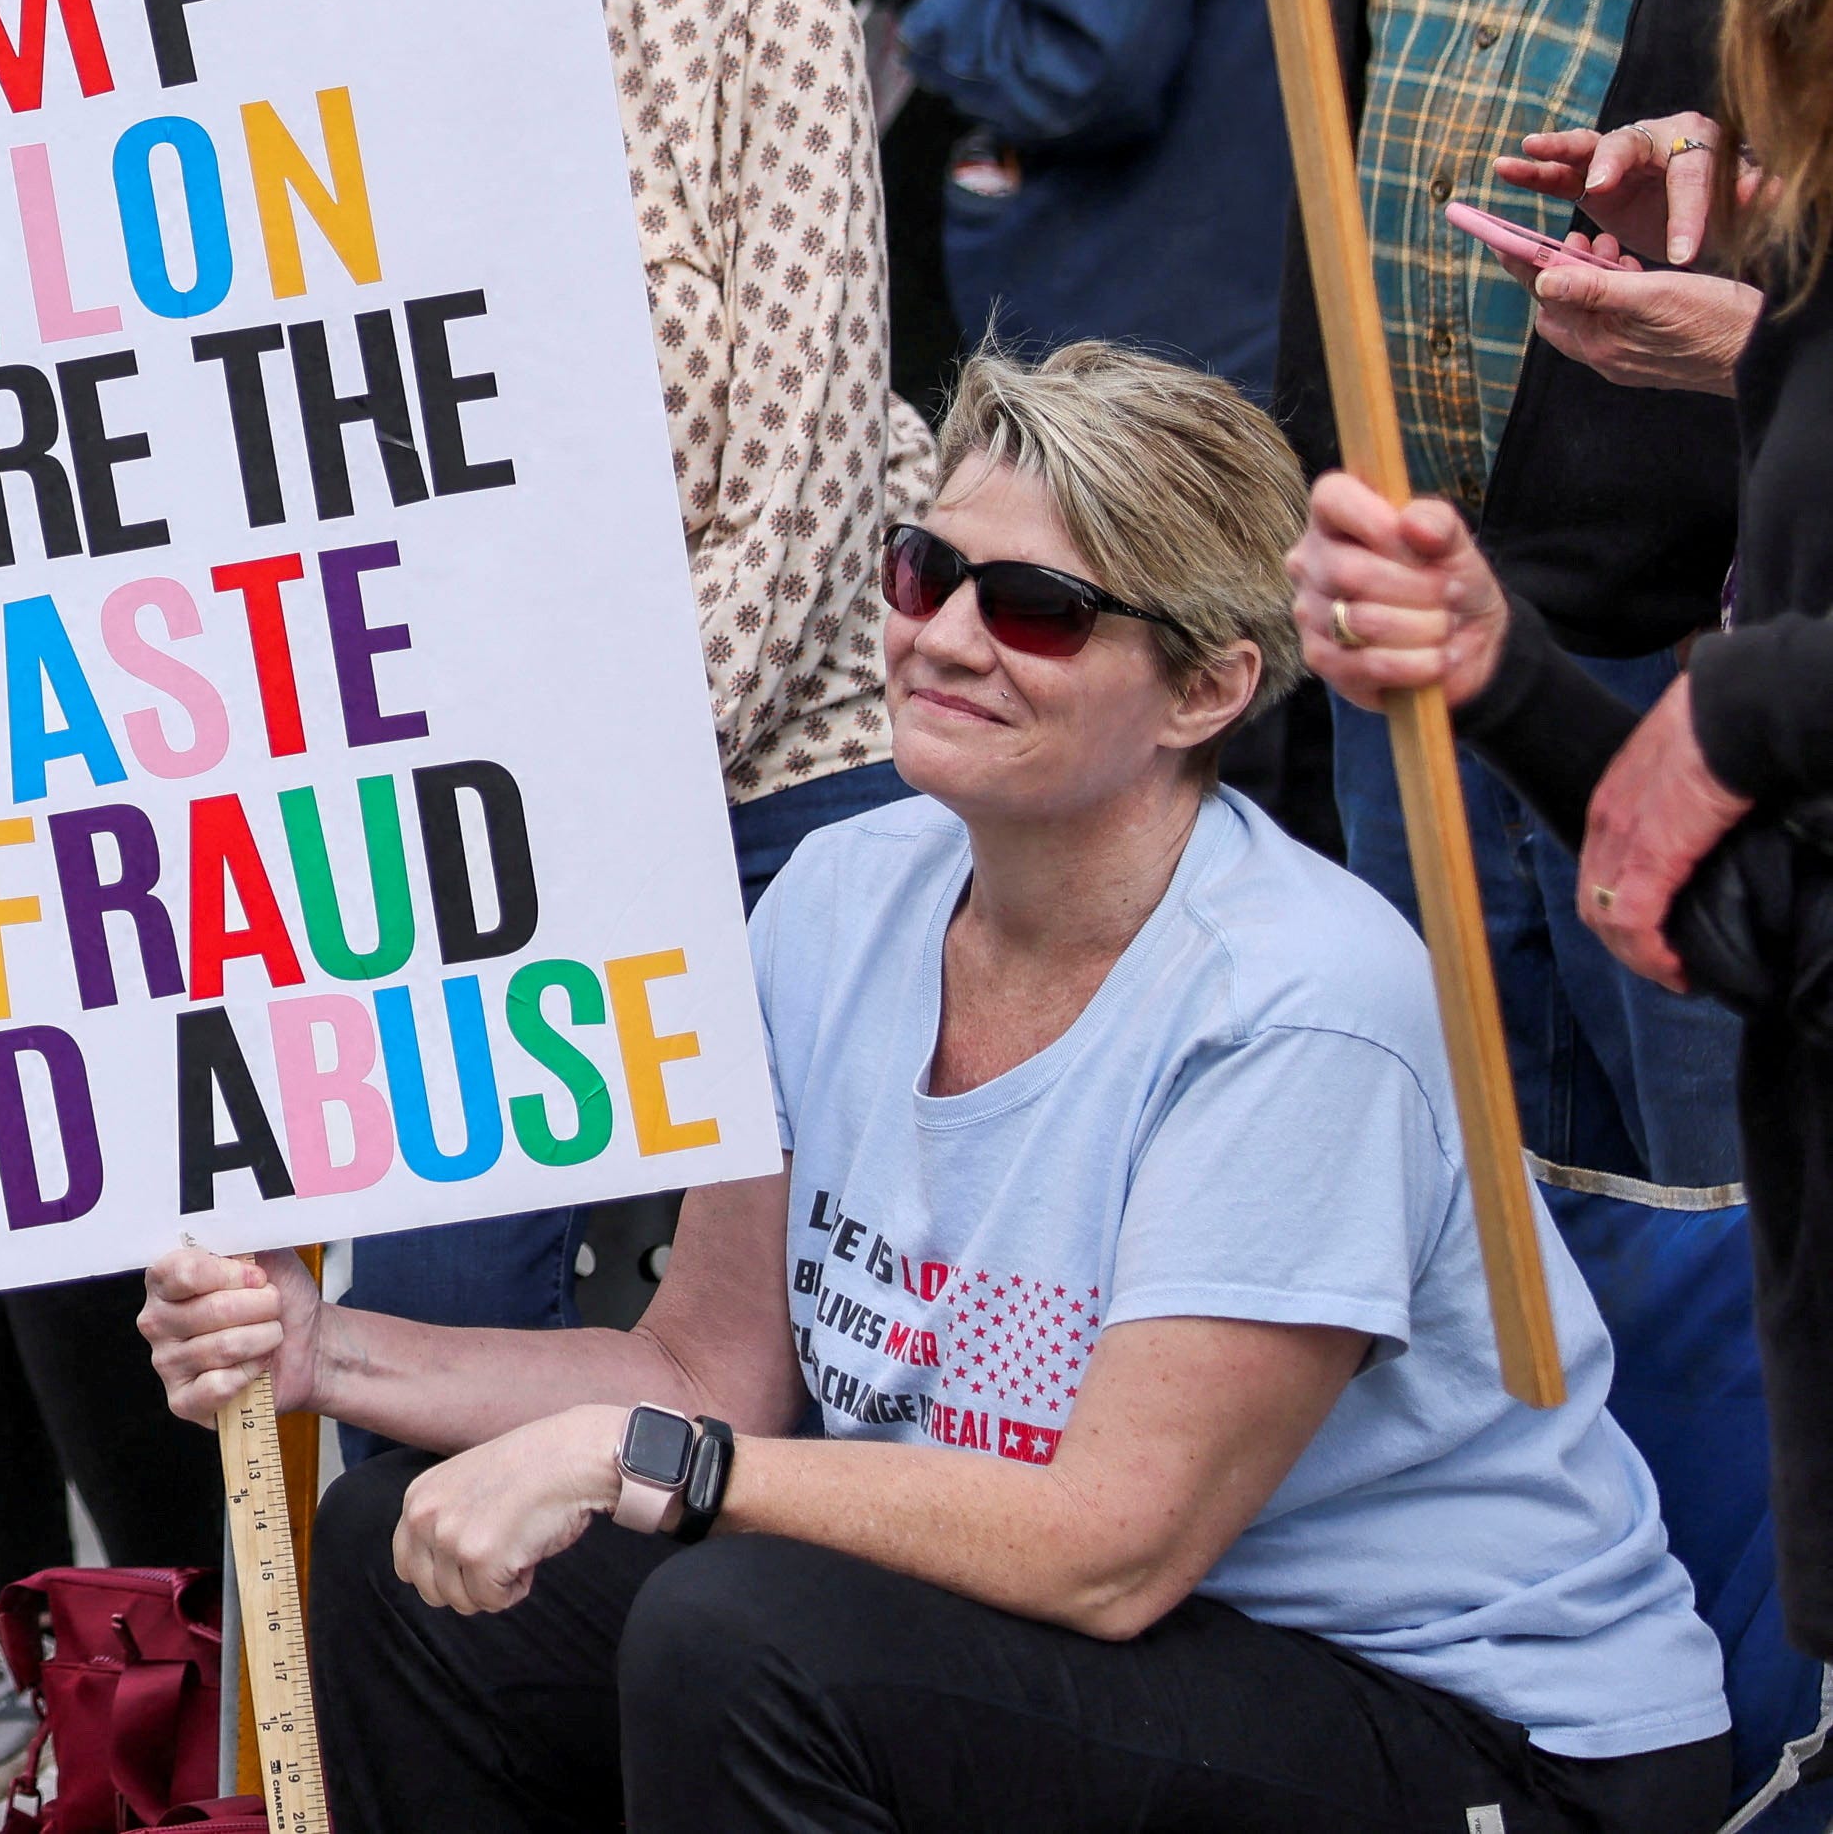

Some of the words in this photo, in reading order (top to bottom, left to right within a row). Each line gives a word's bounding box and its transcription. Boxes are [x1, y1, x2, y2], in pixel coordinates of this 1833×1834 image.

[191, 288, 516, 528] THE
[179, 947, 720, 1216] ABUSE
[864, 1233, 893, 1285] IS
[815, 1284, 887, 1350] LIVES
[240, 1408, 255, 1430] 12
[930, 1401, 991, 1451] REAL
[247, 1458, 261, 1480] 13
[253, 1509, 268, 1531] 14
[260, 1559, 274, 1581] 15
[266, 1610, 281, 1631] 16
[273, 1661, 287, 1681] 17
[279, 1711, 294, 1733] 18
[286, 1761, 301, 1783] 19
[273, 1779, 286, 1830] CHARLES
[293, 1811, 307, 1834] 20
